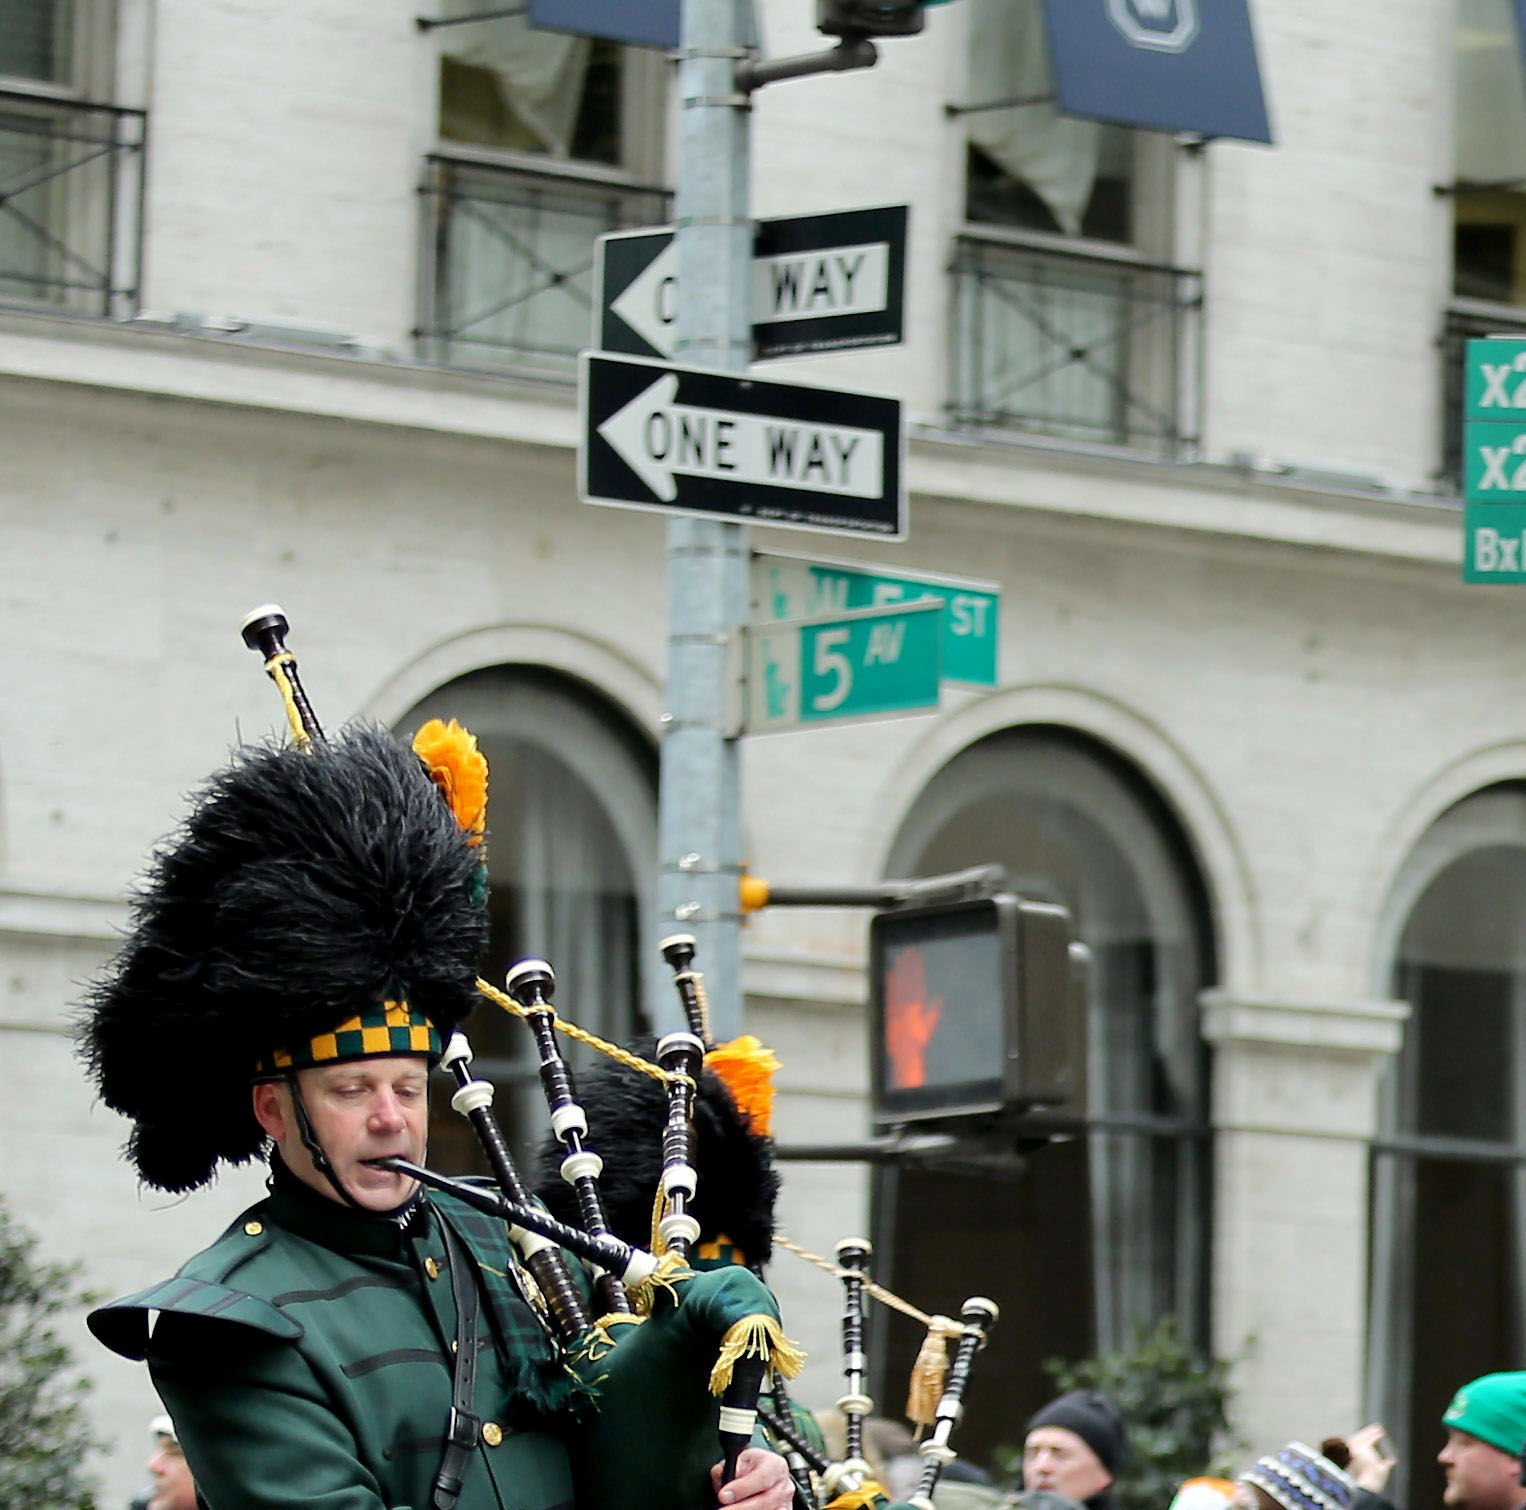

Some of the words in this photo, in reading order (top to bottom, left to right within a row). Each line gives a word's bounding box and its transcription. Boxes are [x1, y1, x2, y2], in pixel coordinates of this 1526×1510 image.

[771, 254, 865, 313] WAY
[645, 410, 735, 473] ONE
[764, 427, 861, 486] WAY
[950, 596, 991, 637] ST
[812, 627, 854, 712] 5
[863, 621, 907, 667] AV
